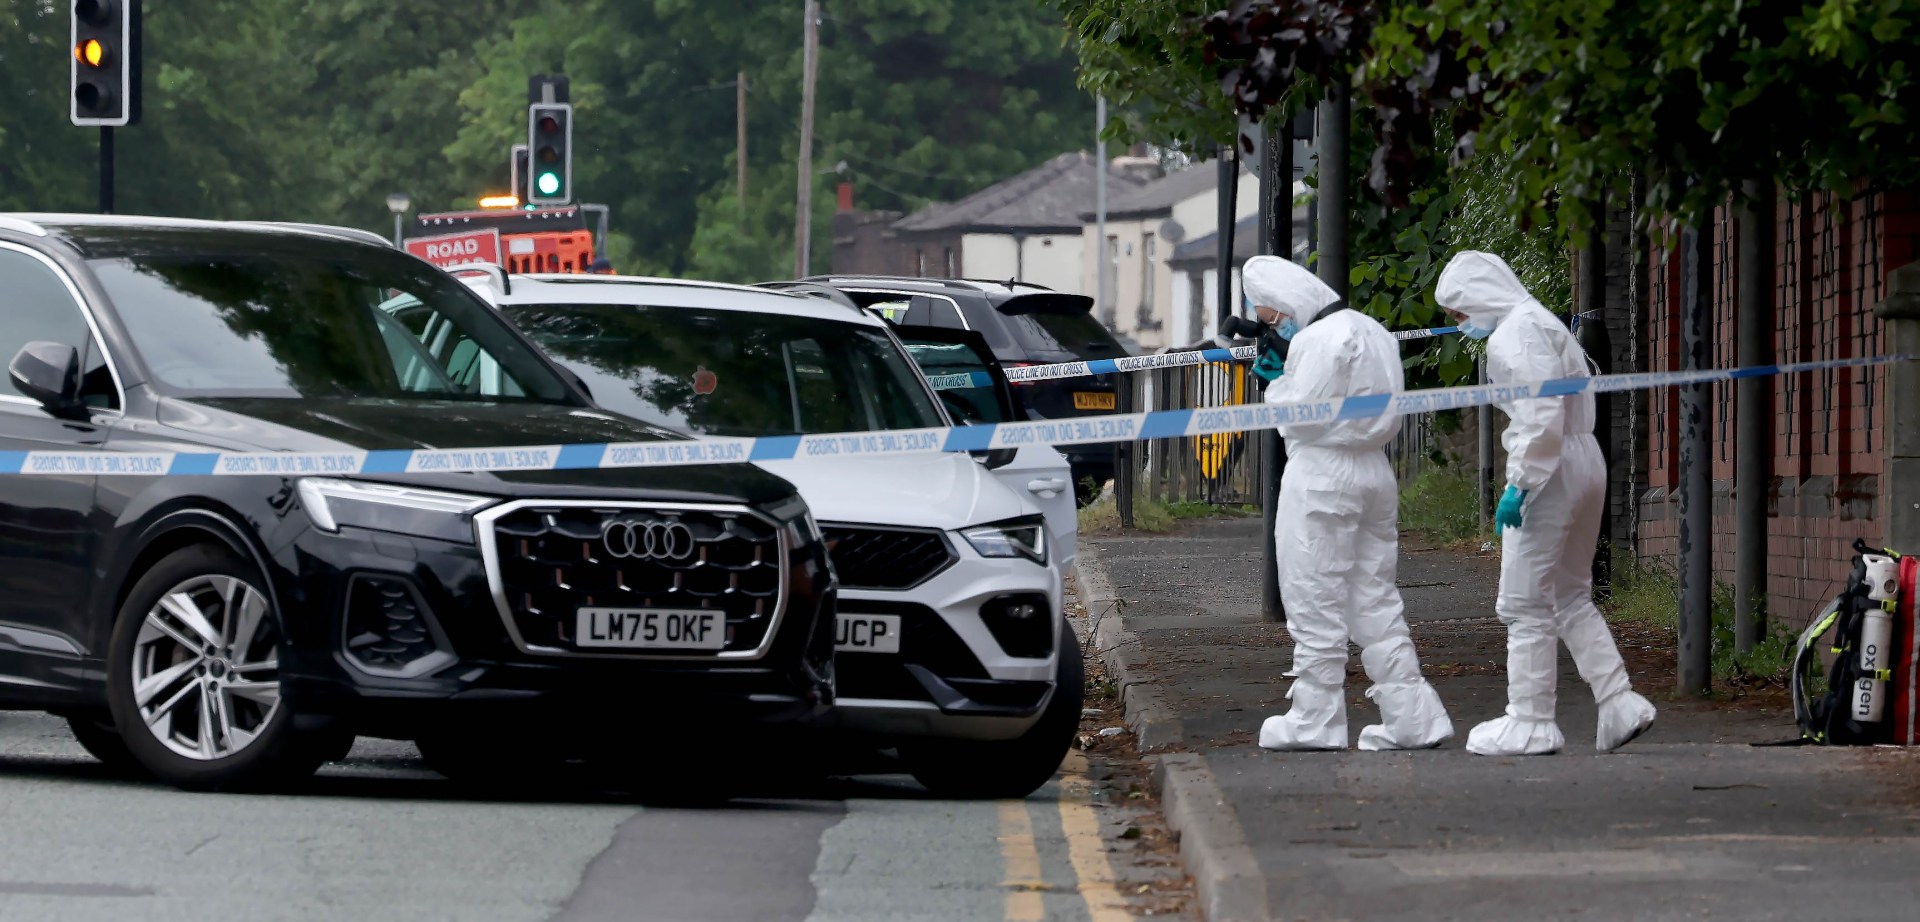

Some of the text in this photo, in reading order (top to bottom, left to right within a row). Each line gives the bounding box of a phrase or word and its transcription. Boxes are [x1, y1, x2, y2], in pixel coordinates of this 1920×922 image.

[426, 238, 478, 260] ROAD
[1120, 352, 1199, 370] POLICE LINE DO NOT CROSS
[1236, 346, 1256, 358] POLICE
[1026, 367, 1039, 378] LINE
[1040, 366, 1049, 377] DO
[1050, 364, 1063, 376] NOT
[1064, 362, 1084, 374] CROSS
[932, 376, 944, 388] NOT
[946, 375, 967, 386] CROSS
[590, 612, 714, 642] LM75 OKF
[834, 619, 887, 647] UCP
[1858, 644, 1877, 716] oxgen
